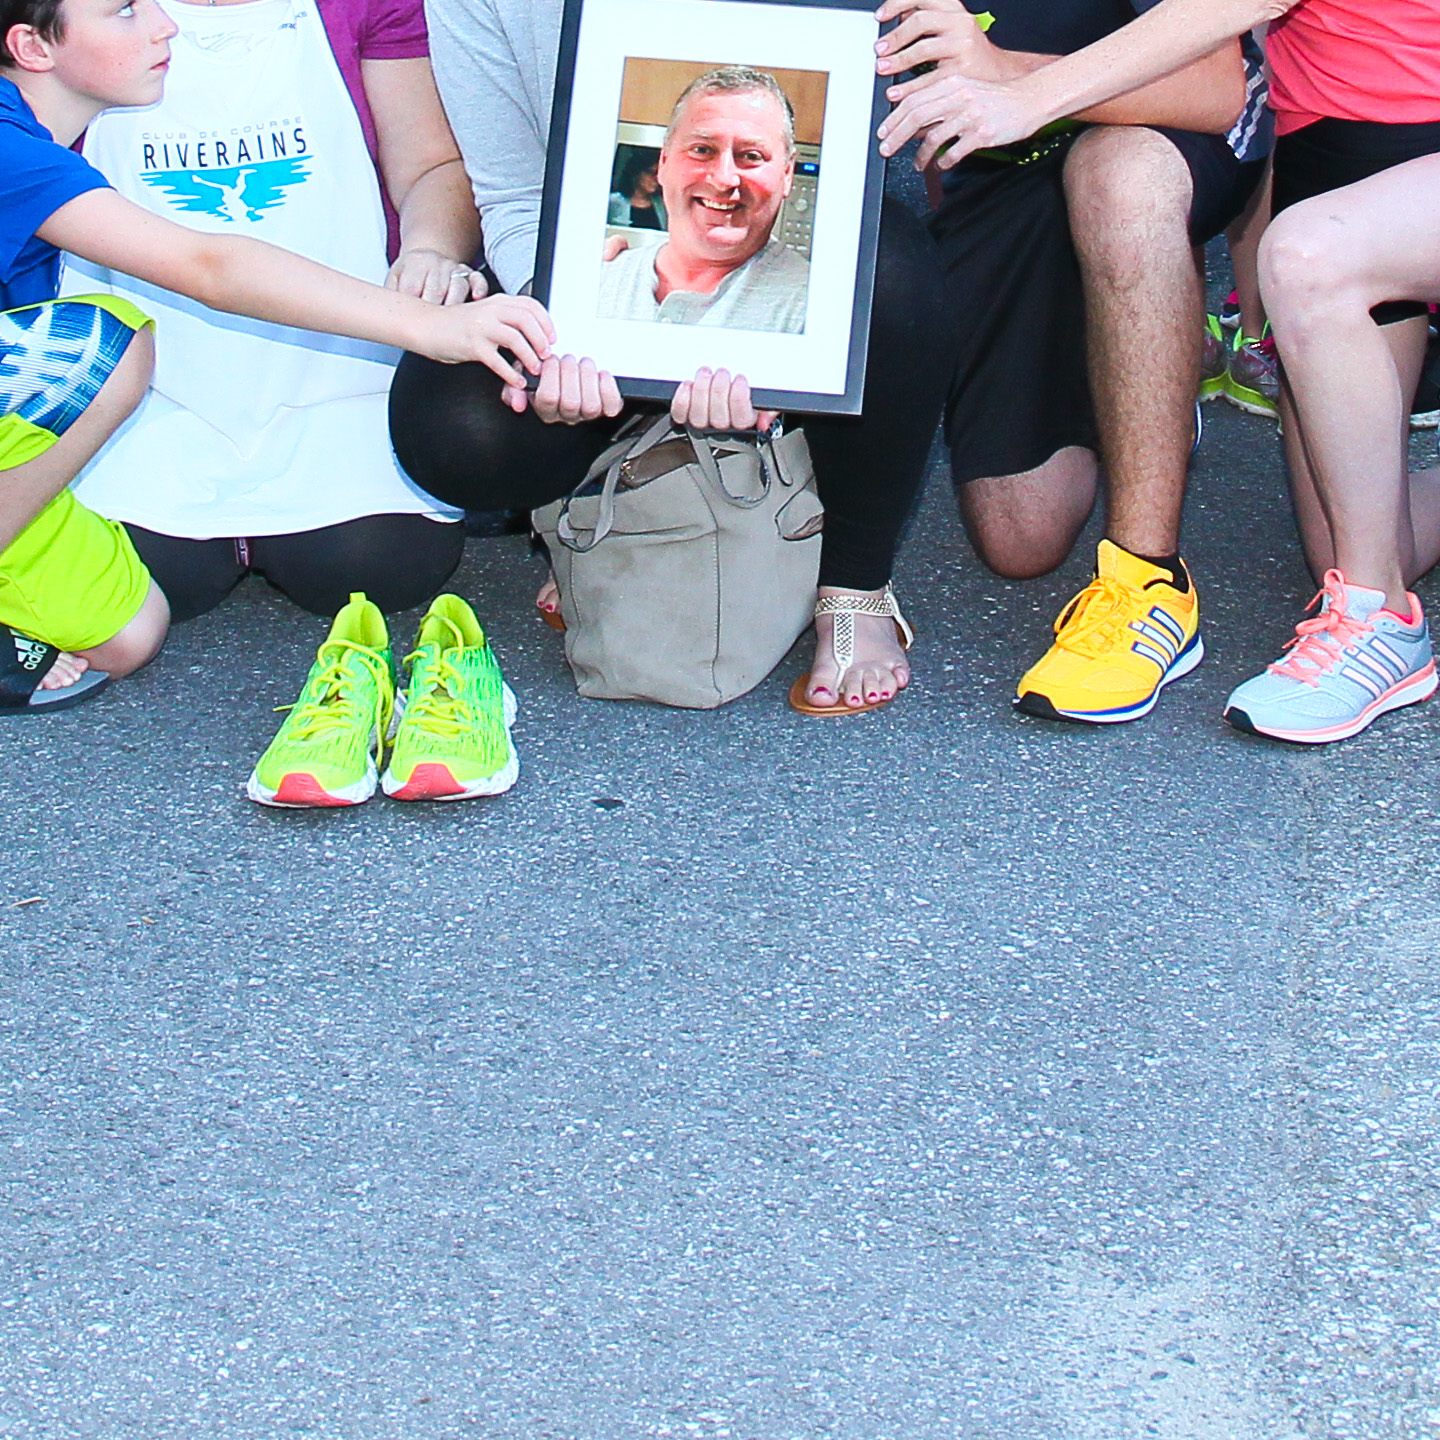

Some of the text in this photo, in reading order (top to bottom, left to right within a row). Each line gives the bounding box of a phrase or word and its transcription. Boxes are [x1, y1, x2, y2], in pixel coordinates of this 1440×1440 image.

[142, 116, 303, 140] CLUB DE COURSE
[143, 127, 307, 169] RIVERAINS
